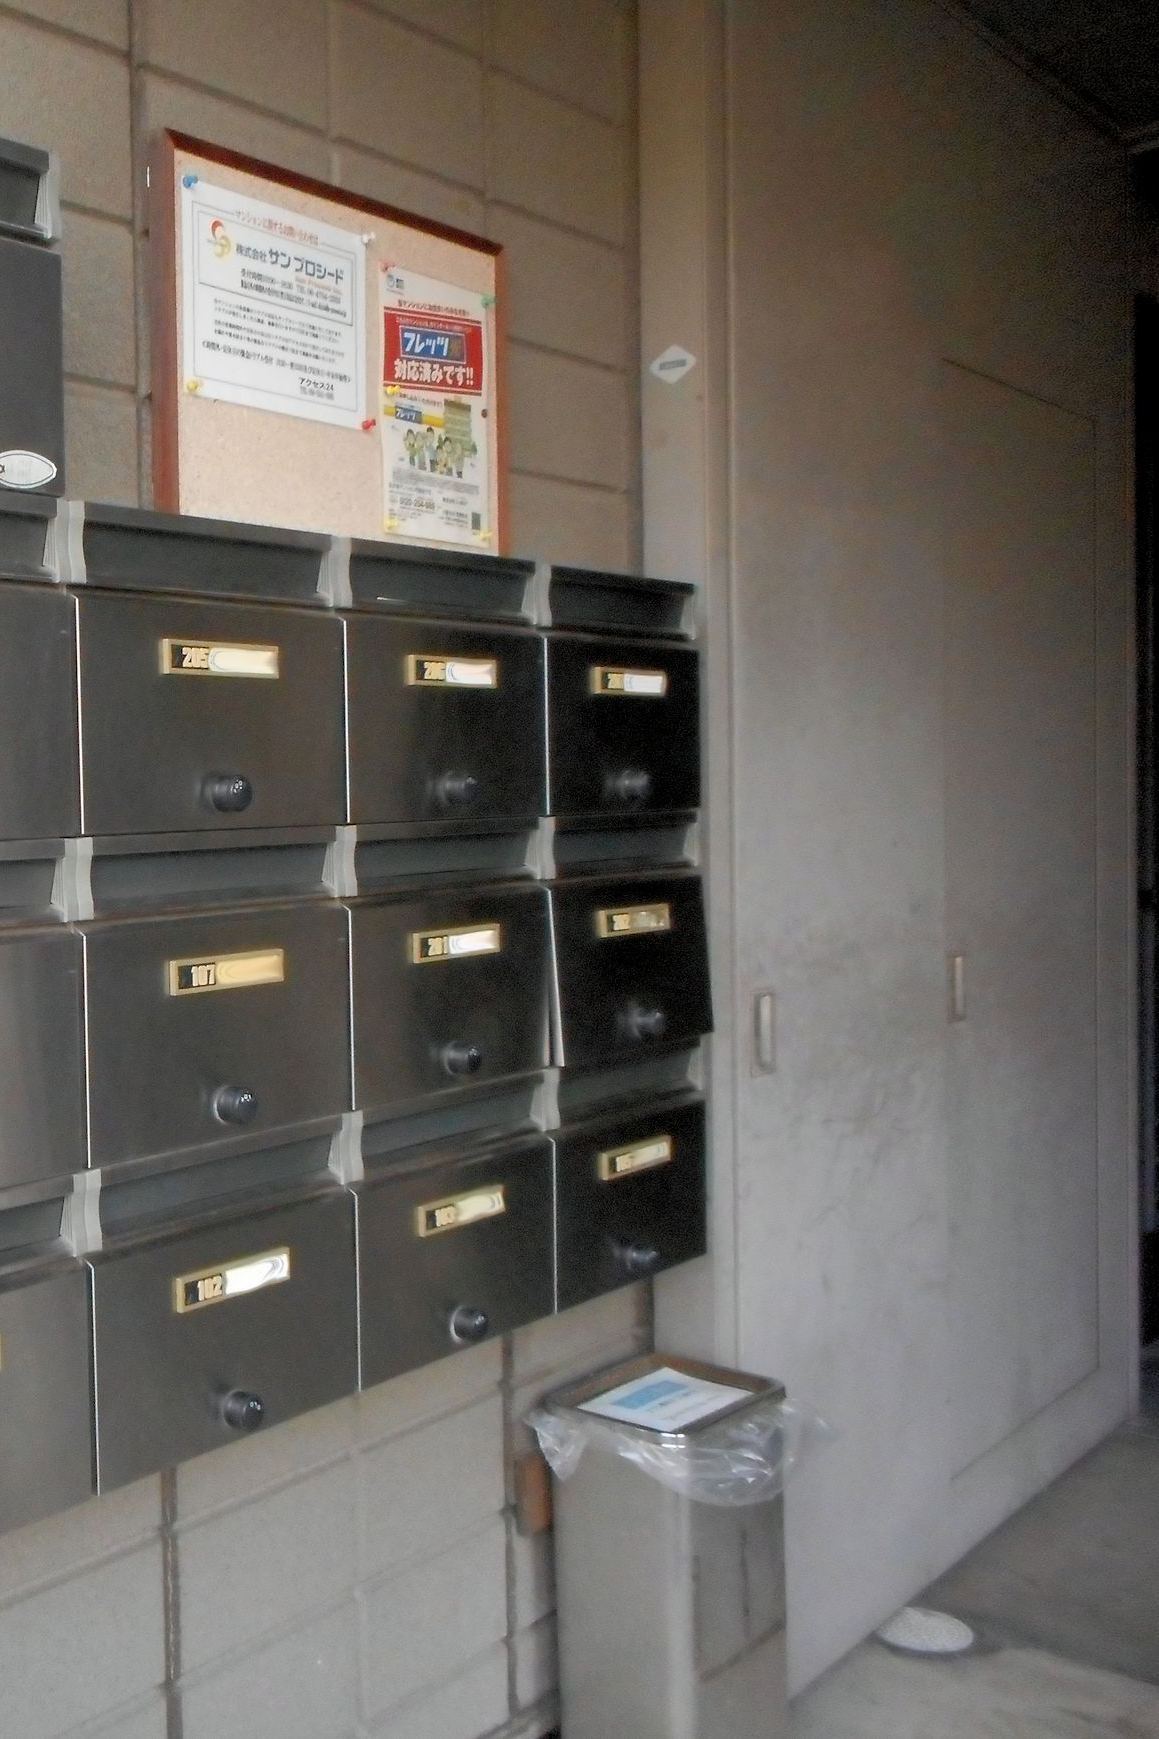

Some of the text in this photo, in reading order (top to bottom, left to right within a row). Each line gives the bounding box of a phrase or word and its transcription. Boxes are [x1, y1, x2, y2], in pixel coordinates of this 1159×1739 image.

[403, 331, 449, 357] フレッツ
[191, 964, 215, 987] 107
[197, 1275, 222, 1301] 102
